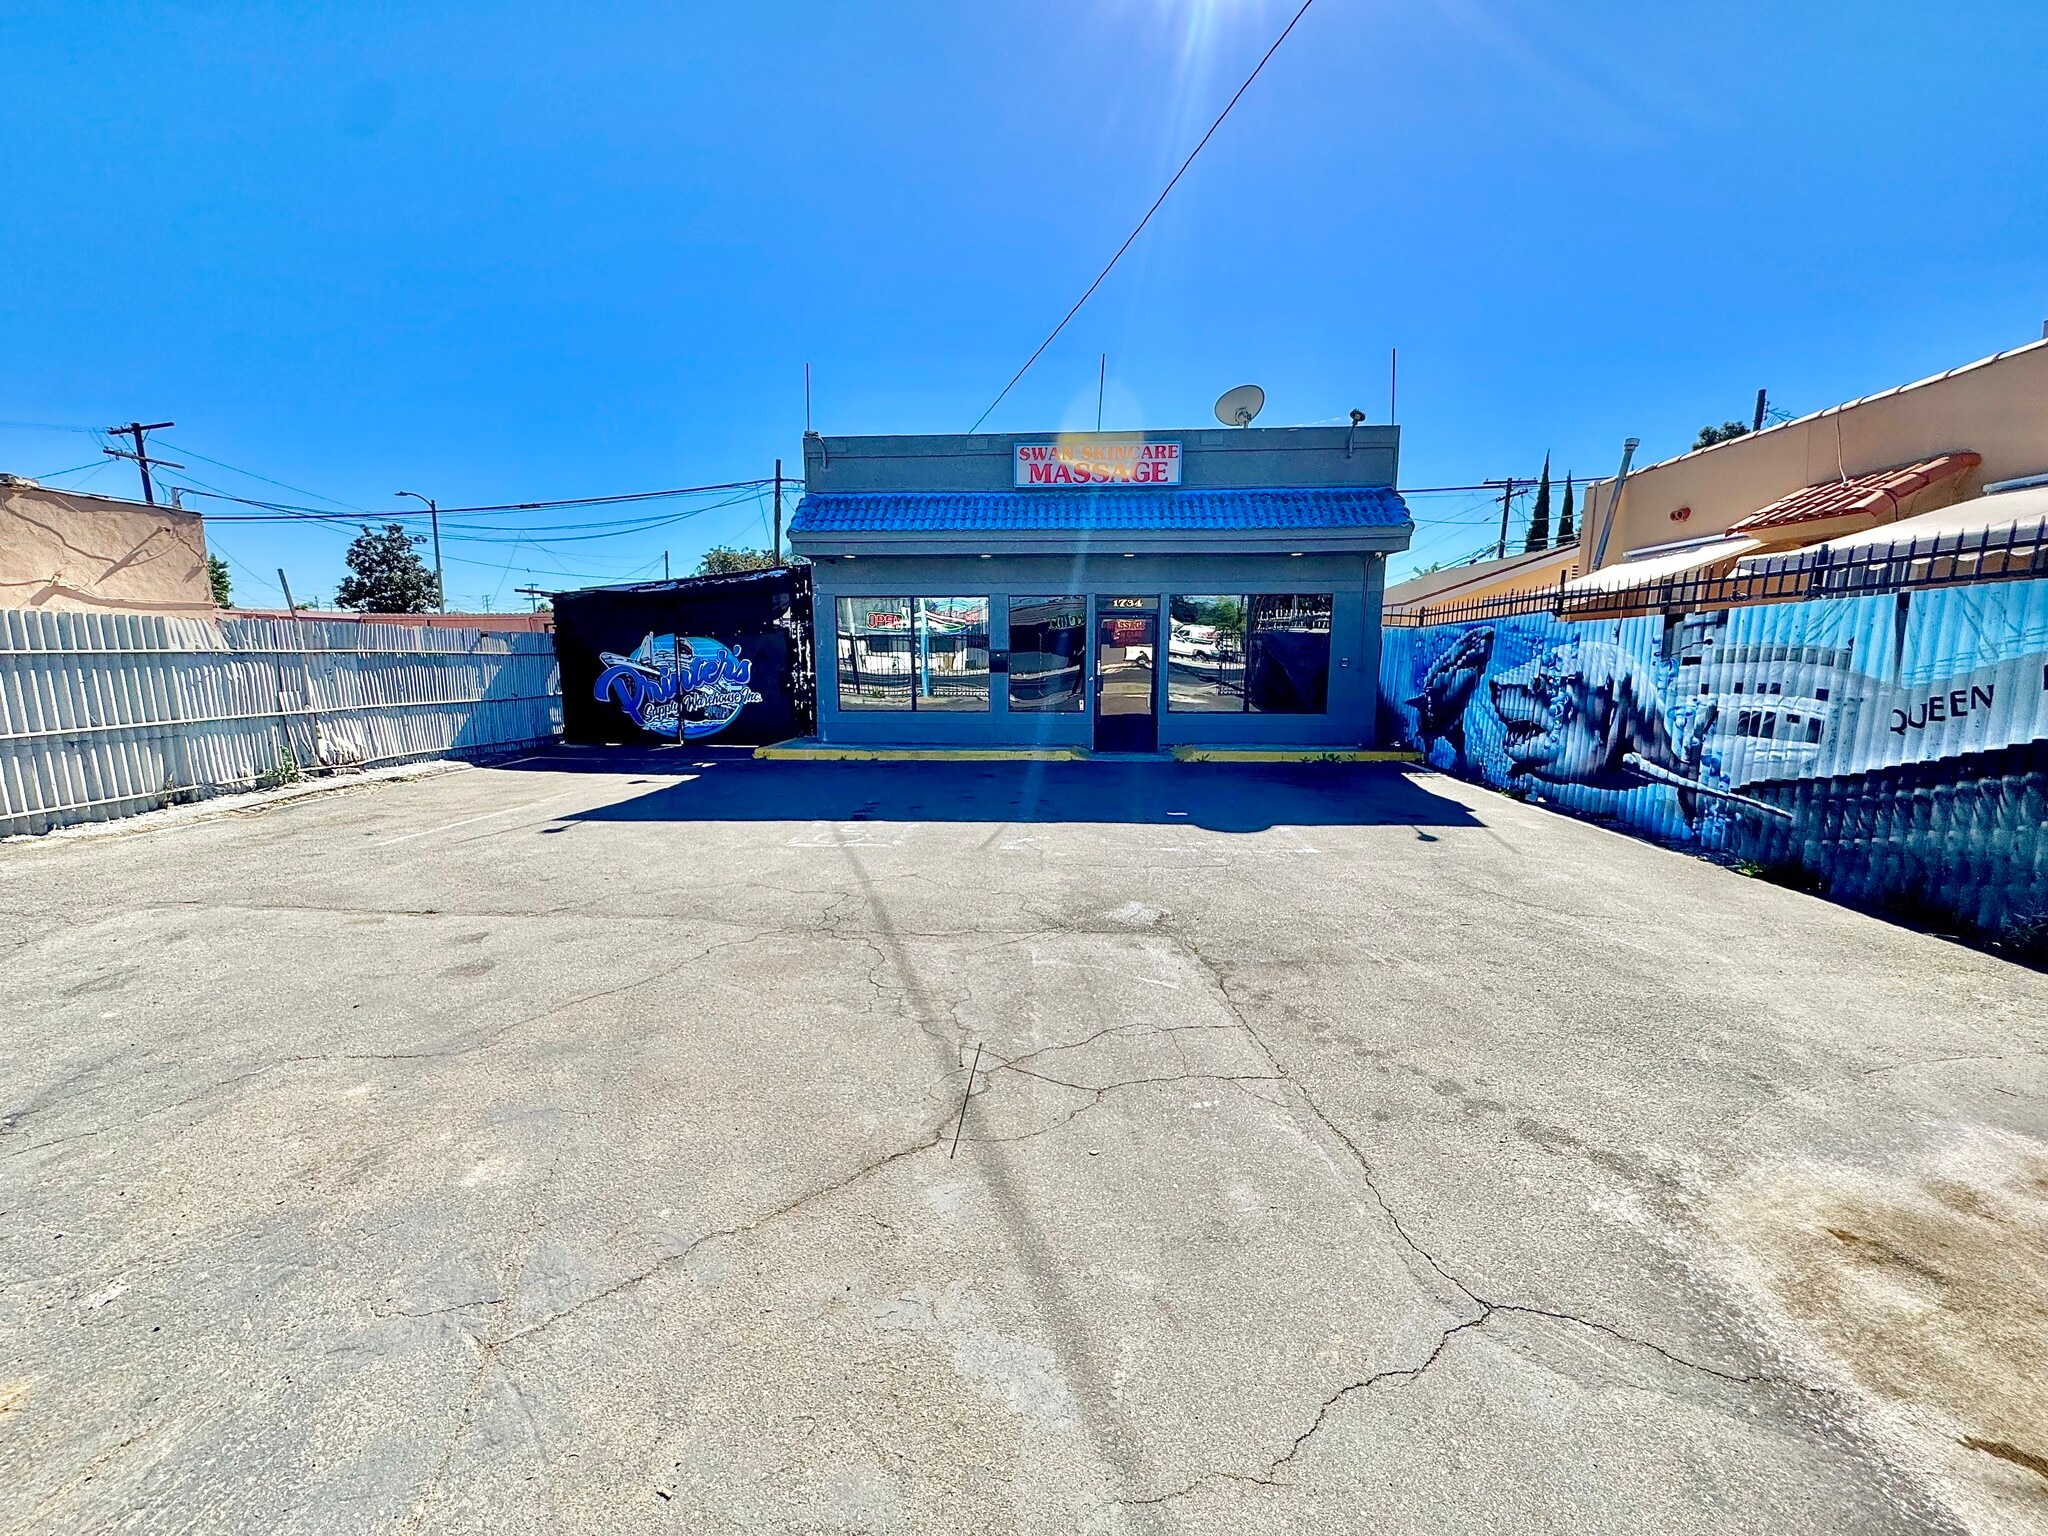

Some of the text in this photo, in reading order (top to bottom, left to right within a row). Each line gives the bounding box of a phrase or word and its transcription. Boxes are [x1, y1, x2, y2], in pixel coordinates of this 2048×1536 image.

[1019, 445, 1179, 461] SWAN SKINCARE
[1028, 461, 1169, 484] MASSAGE
[1112, 599, 1143, 608] 1734
[868, 613, 903, 630] OPEN
[593, 644, 753, 726] Printer's
[683, 691, 742, 712] Warehouse
[1889, 683, 1995, 736] QUEEN
